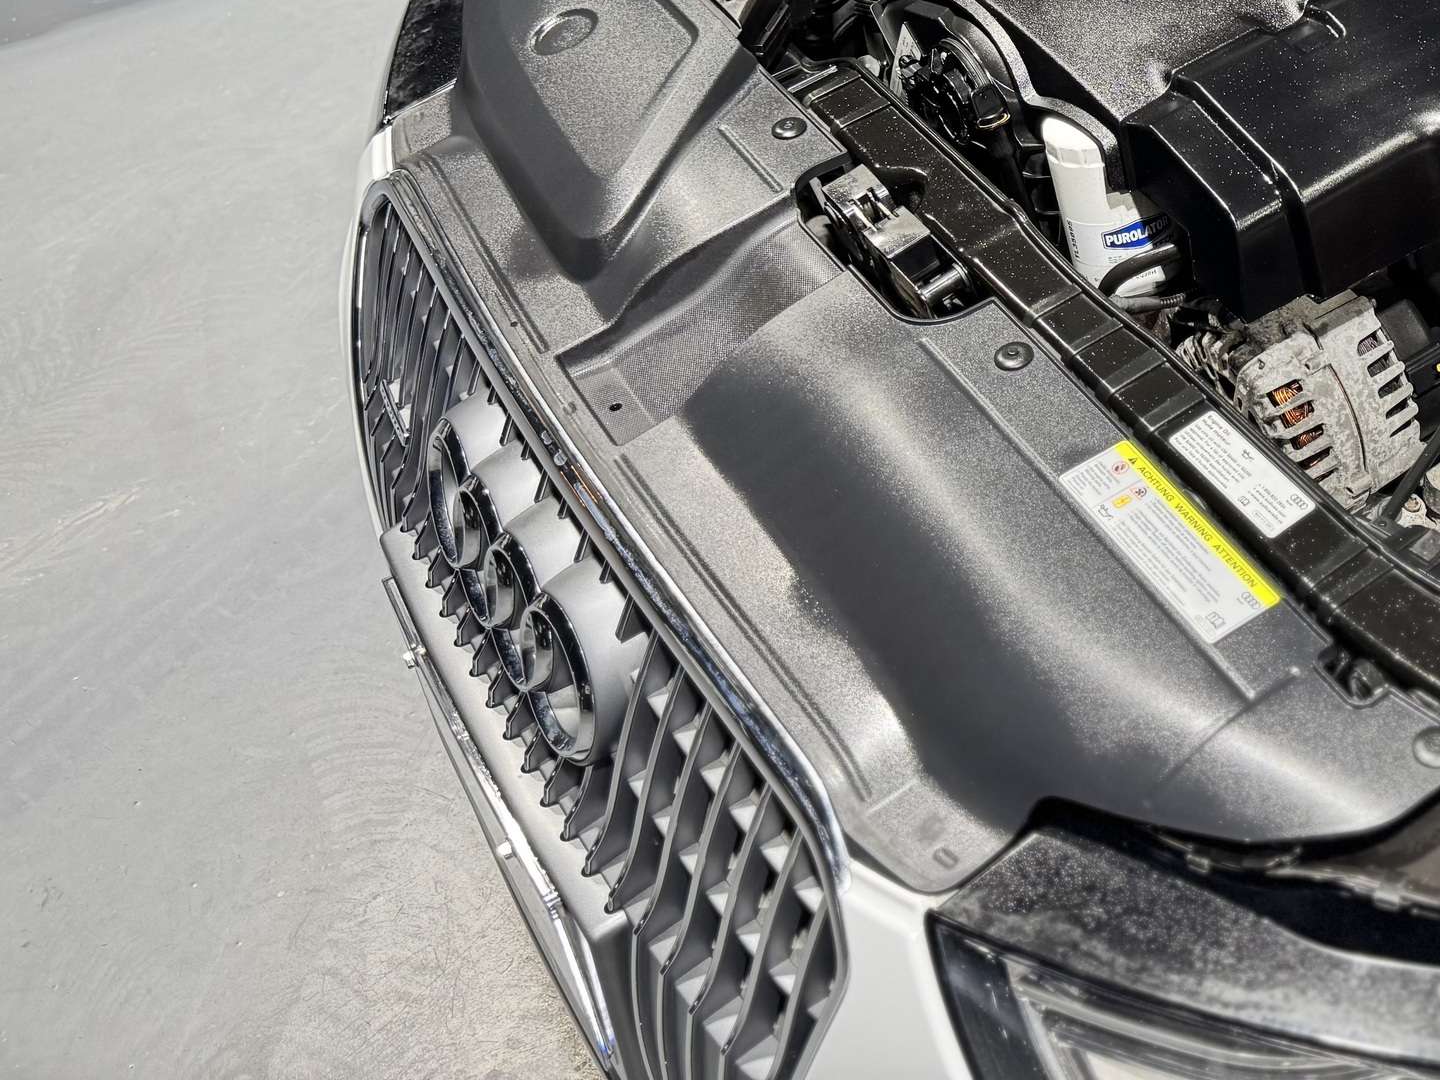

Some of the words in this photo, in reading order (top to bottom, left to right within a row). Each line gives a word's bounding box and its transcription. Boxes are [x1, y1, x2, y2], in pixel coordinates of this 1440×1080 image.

[1105, 216, 1169, 246] PUROLATOR
[1136, 465, 1175, 502] ACHTUNG
[1174, 502, 1214, 542] WARNING
[1212, 542, 1259, 588] ATTENTION
